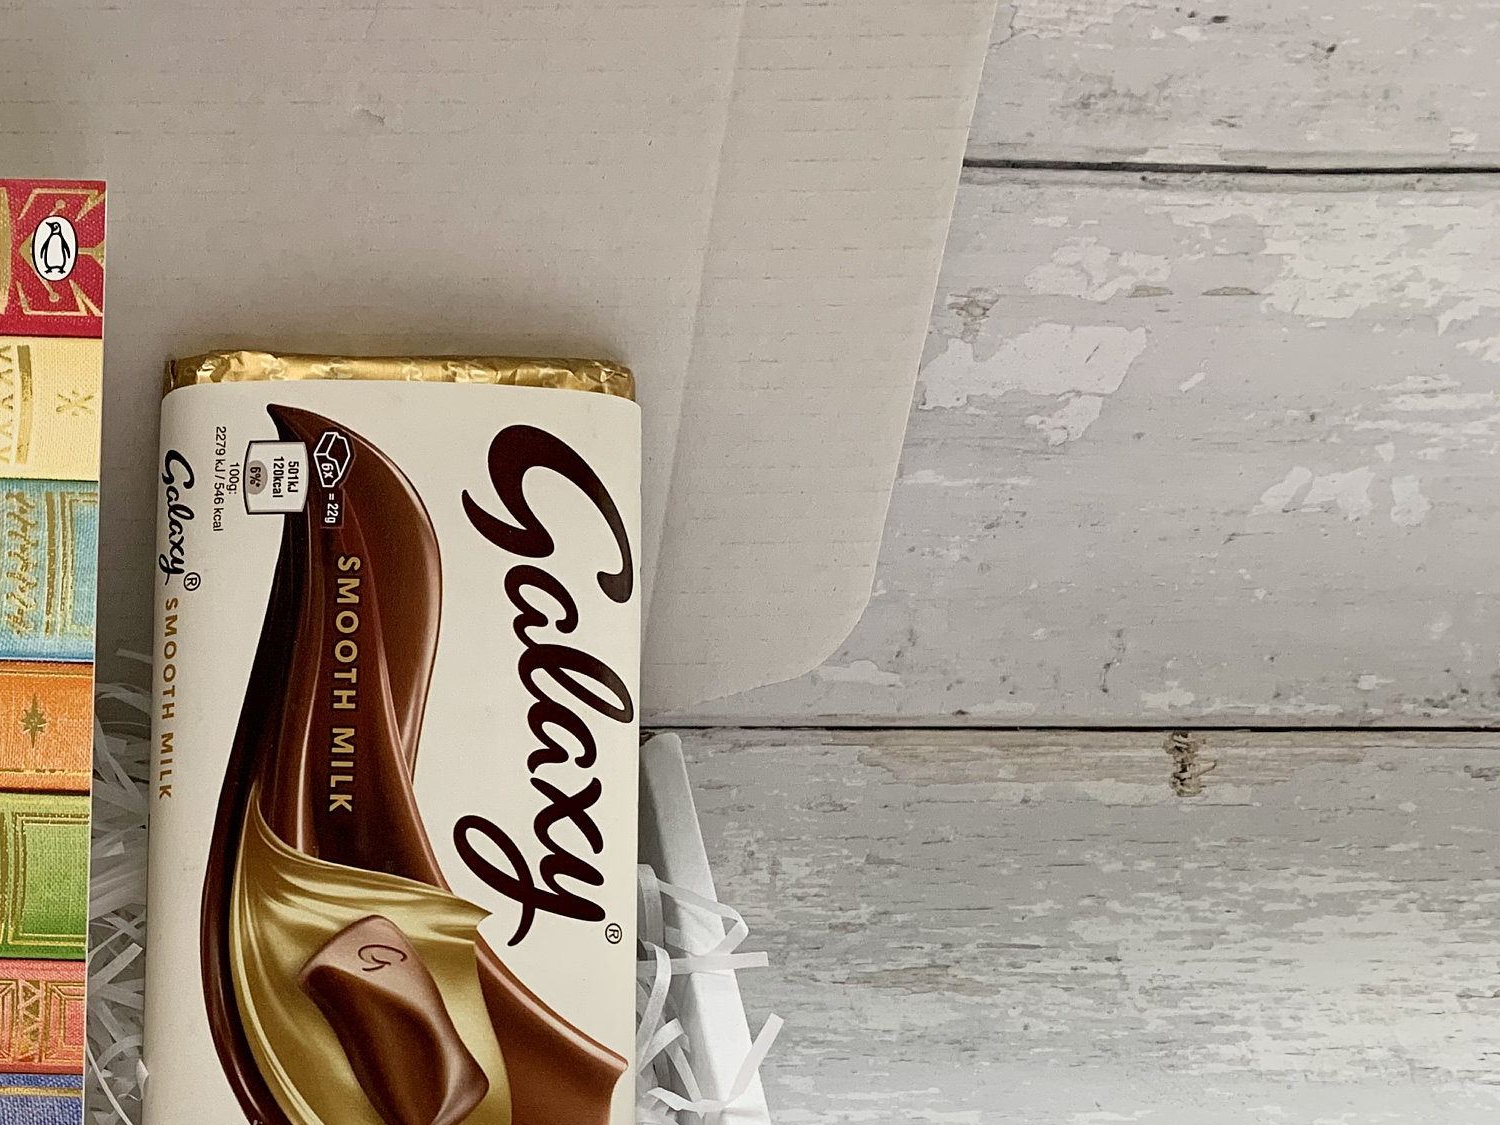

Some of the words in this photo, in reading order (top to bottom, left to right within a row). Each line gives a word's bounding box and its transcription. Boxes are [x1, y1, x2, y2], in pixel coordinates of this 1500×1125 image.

[215, 426, 227, 455] 2279
[214, 459, 226, 473] kJ
[226, 462, 240, 495] 100g:
[272, 456, 285, 498] 120kcal
[287, 461, 299, 493] 501kJ
[214, 483, 225, 505] 546
[213, 507, 224, 532] kcal
[324, 503, 339, 524] 22g
[331, 556, 361, 710] SMOOTH
[162, 598, 179, 721] SMOOTH
[158, 732, 174, 799] MILK
[328, 728, 356, 812] MILK
